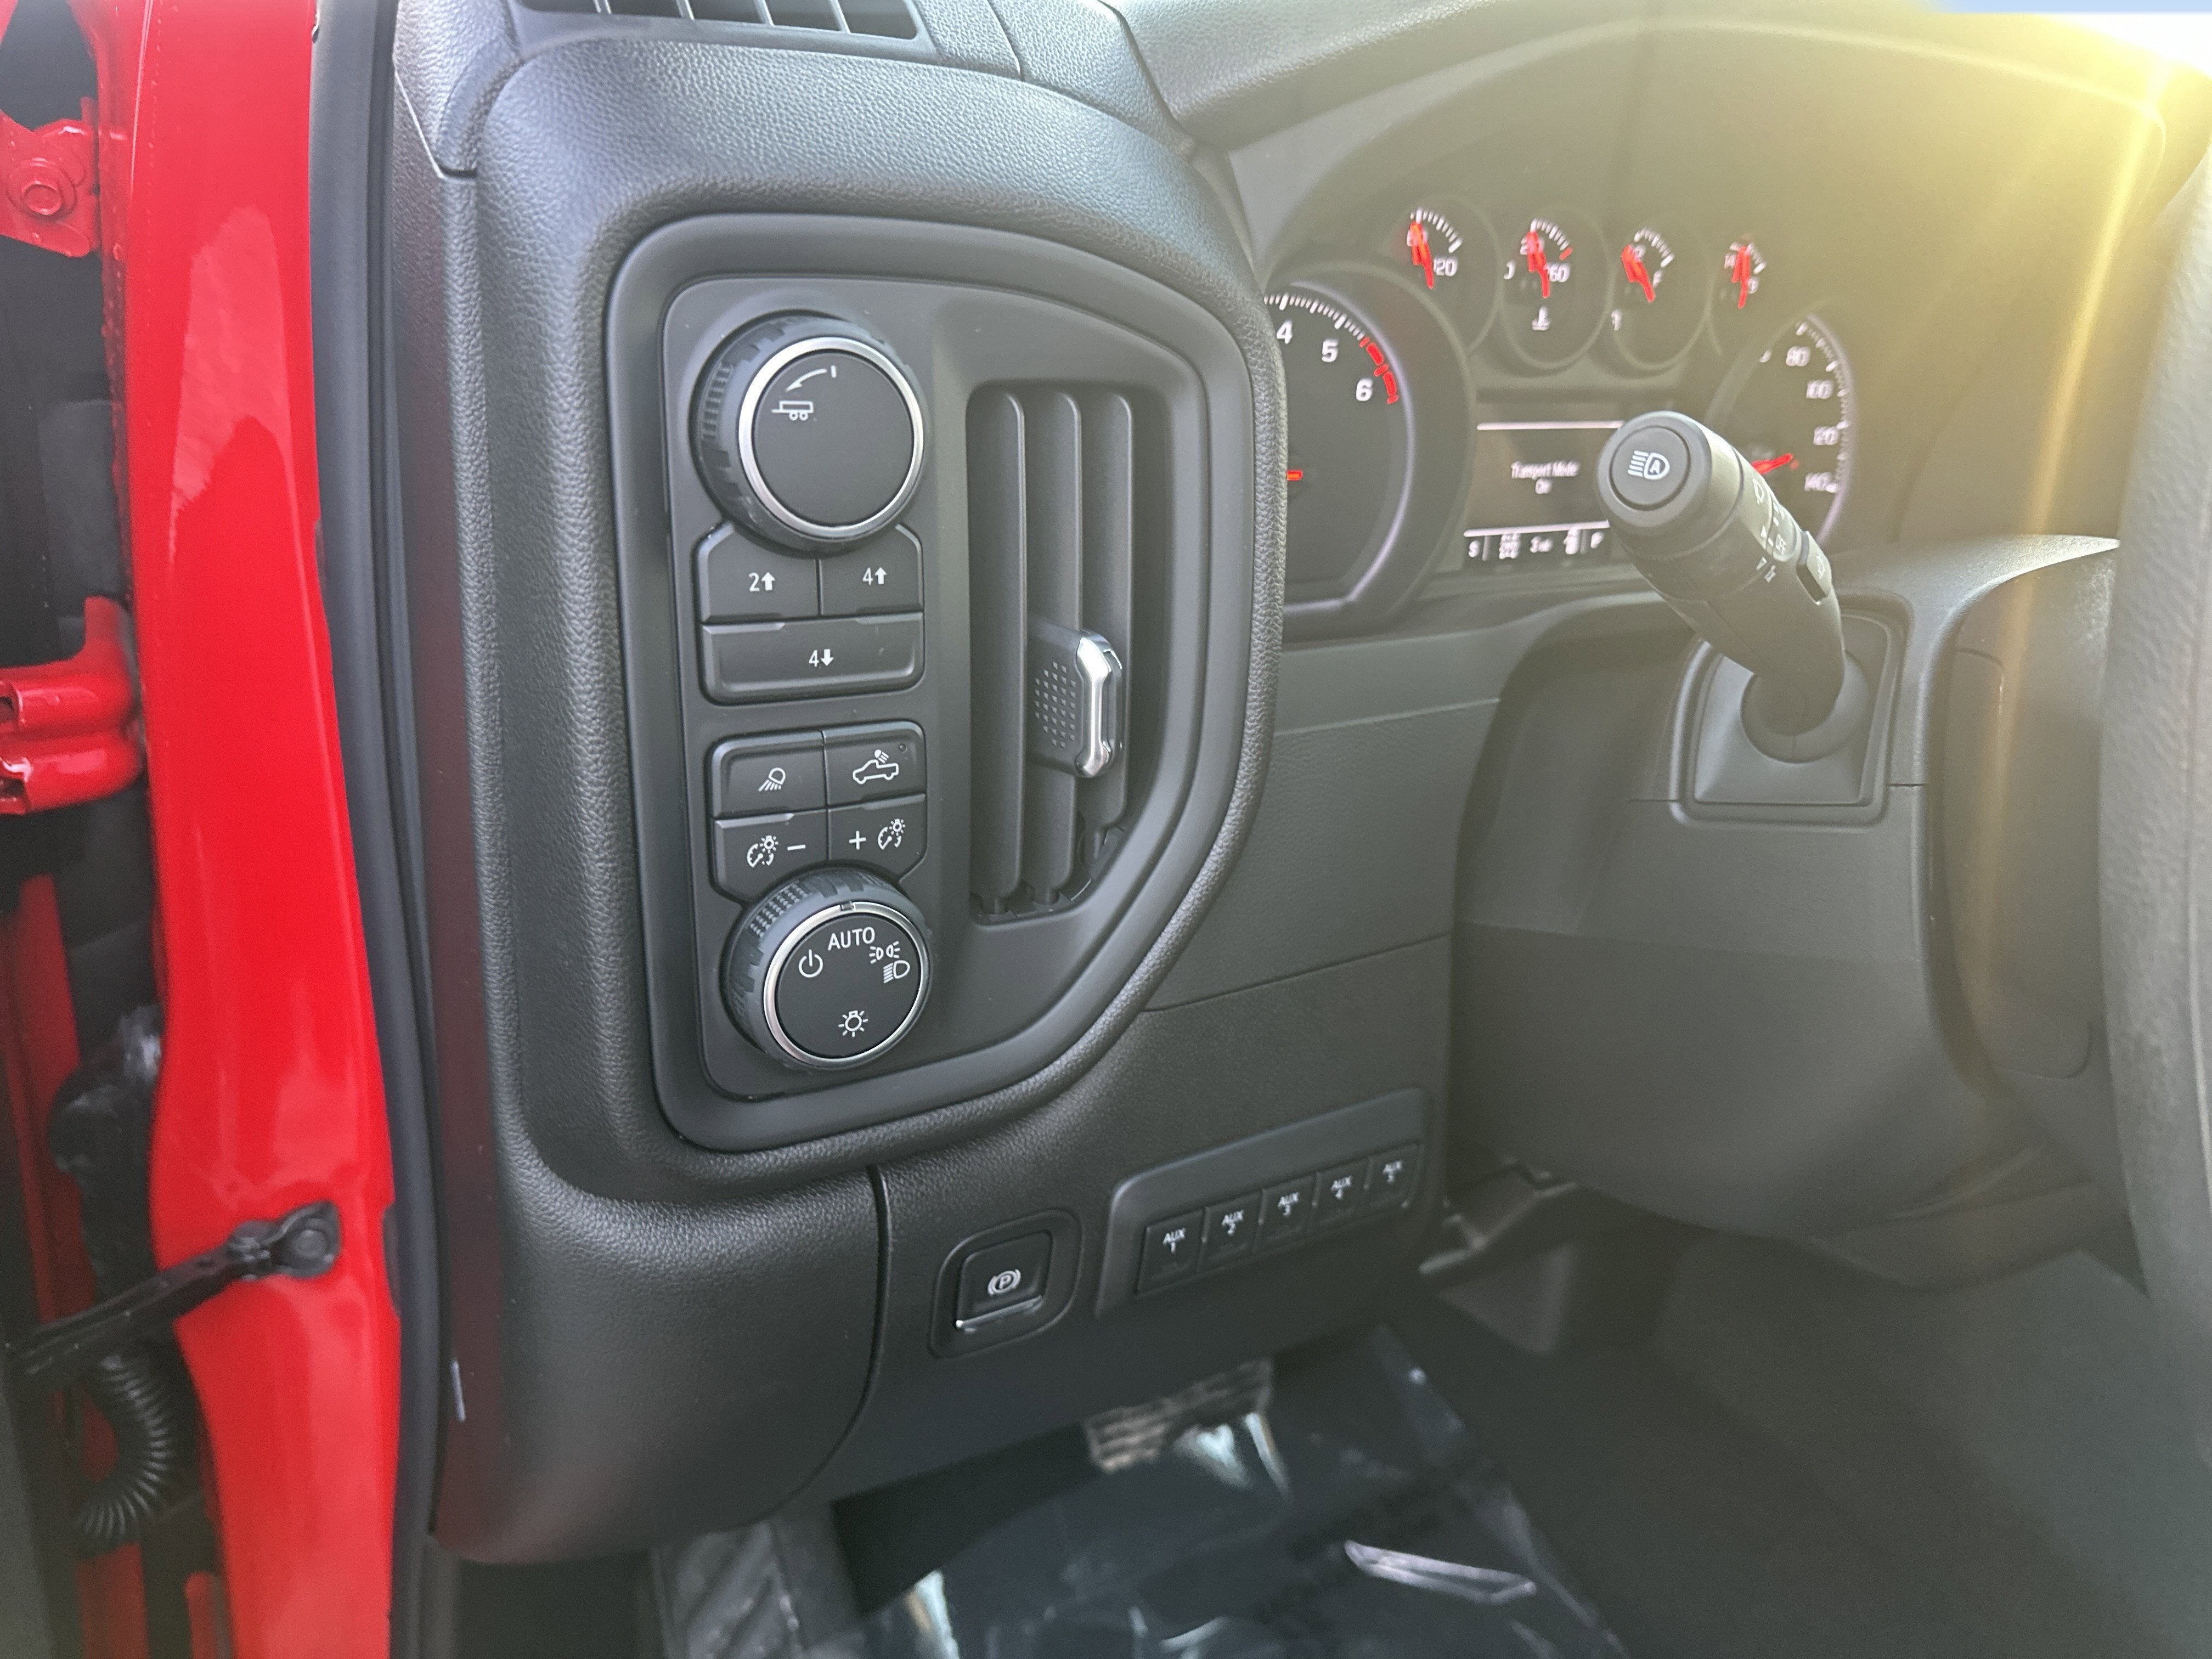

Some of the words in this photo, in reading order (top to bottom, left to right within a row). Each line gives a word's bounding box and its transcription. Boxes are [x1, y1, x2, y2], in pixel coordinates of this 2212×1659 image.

[1433, 256, 1459, 276] 120
[1277, 320, 1293, 345] 4
[1322, 338, 1339, 363] 5
[1786, 346, 1810, 366] 80
[1356, 377, 1374, 402] 6
[748, 572, 760, 592] 2
[862, 567, 873, 585] 4
[809, 650, 820, 668] 4
[827, 927, 875, 951] AUTO
[1382, 1160, 1403, 1175] AUX
[1330, 1175, 1353, 1192] AUX
[1278, 1191, 1300, 1208] AUX
[1334, 1187, 1344, 1200] 4
[1221, 1209, 1244, 1226] AUX
[1283, 1204, 1292, 1217] 3
[1163, 1227, 1186, 1245] AUX
[1227, 1222, 1236, 1236] 2
[1170, 1242, 1176, 1254] 1
